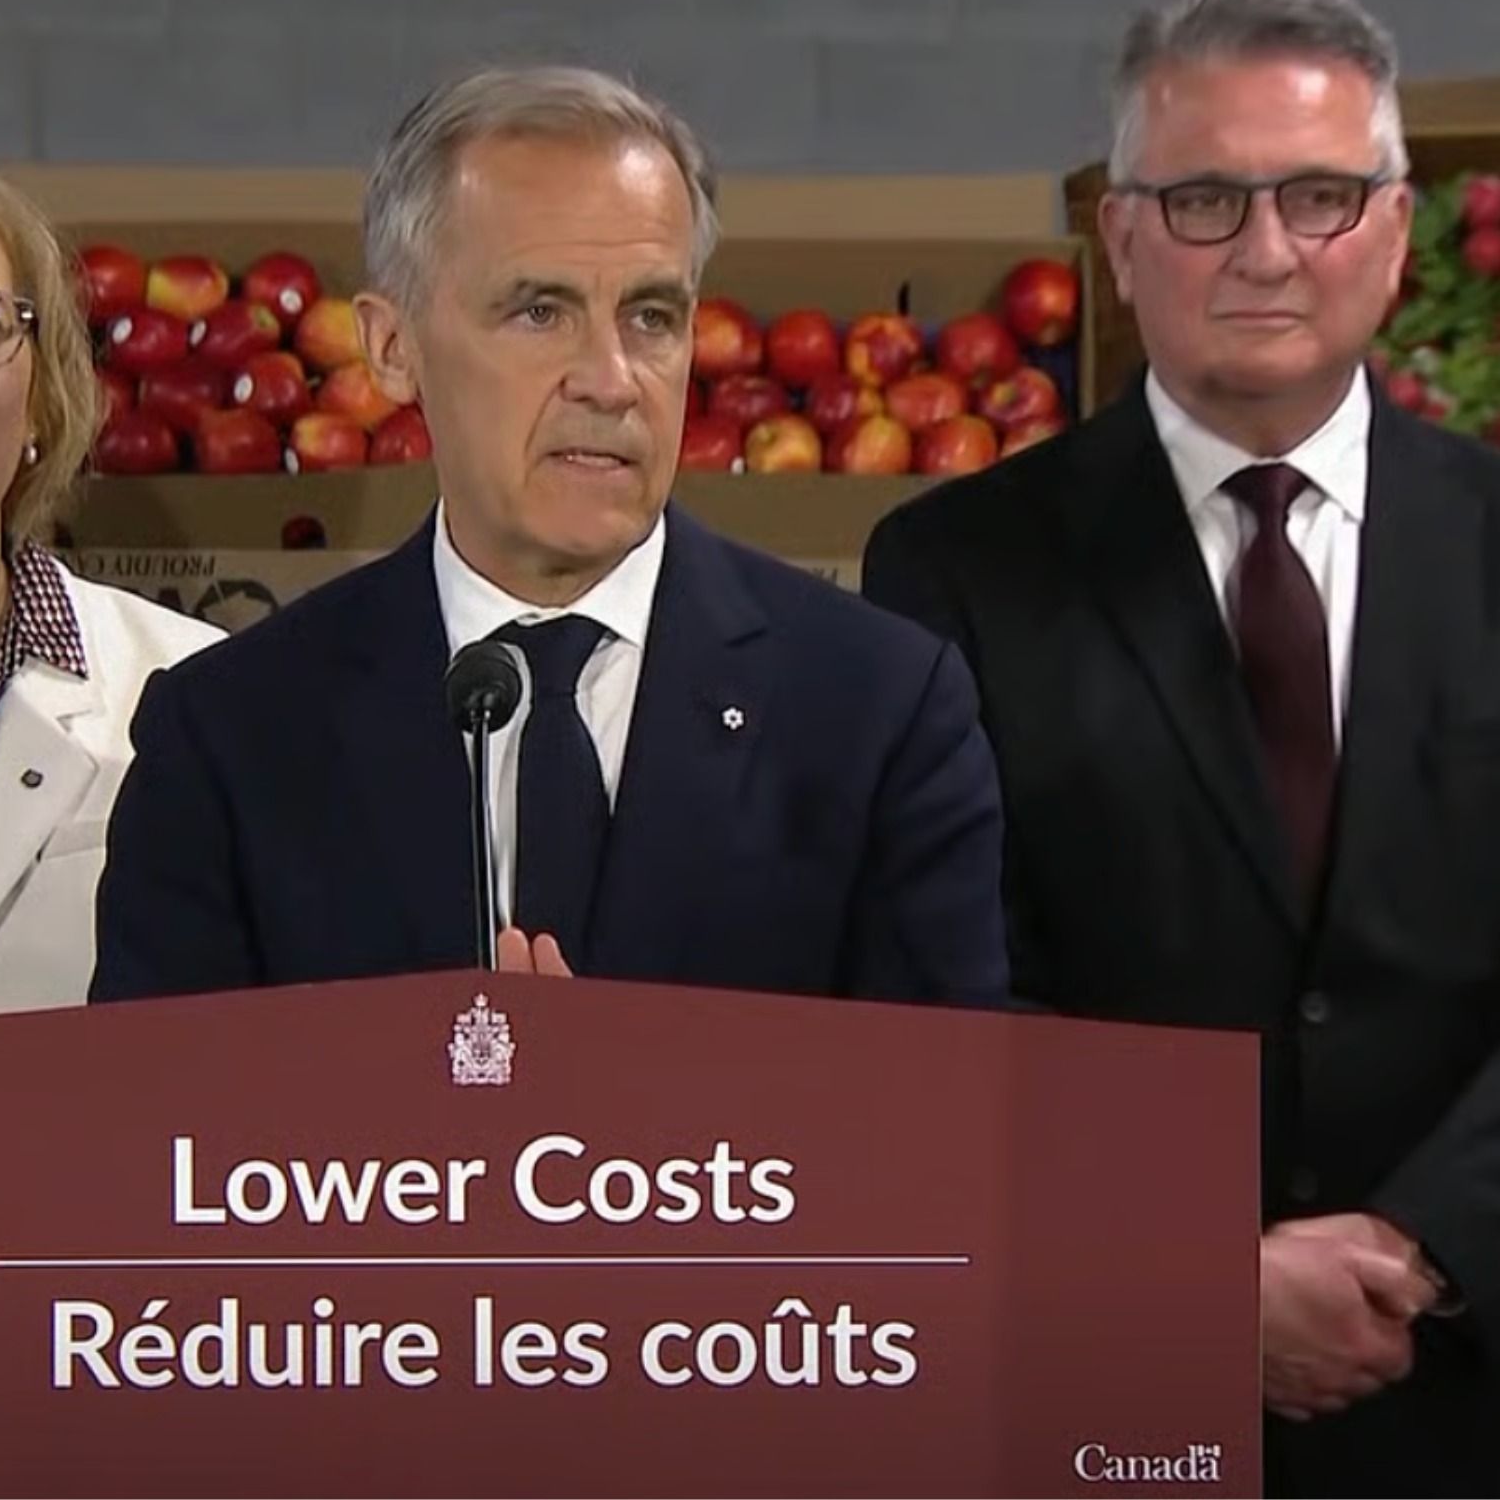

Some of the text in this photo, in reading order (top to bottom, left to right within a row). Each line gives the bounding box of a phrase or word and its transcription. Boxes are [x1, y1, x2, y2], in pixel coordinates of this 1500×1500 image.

[173, 1134, 796, 1225] Lower Costs
[53, 1296, 918, 1388] Réduire les coûts
[1075, 1443, 1221, 1481] Canada
